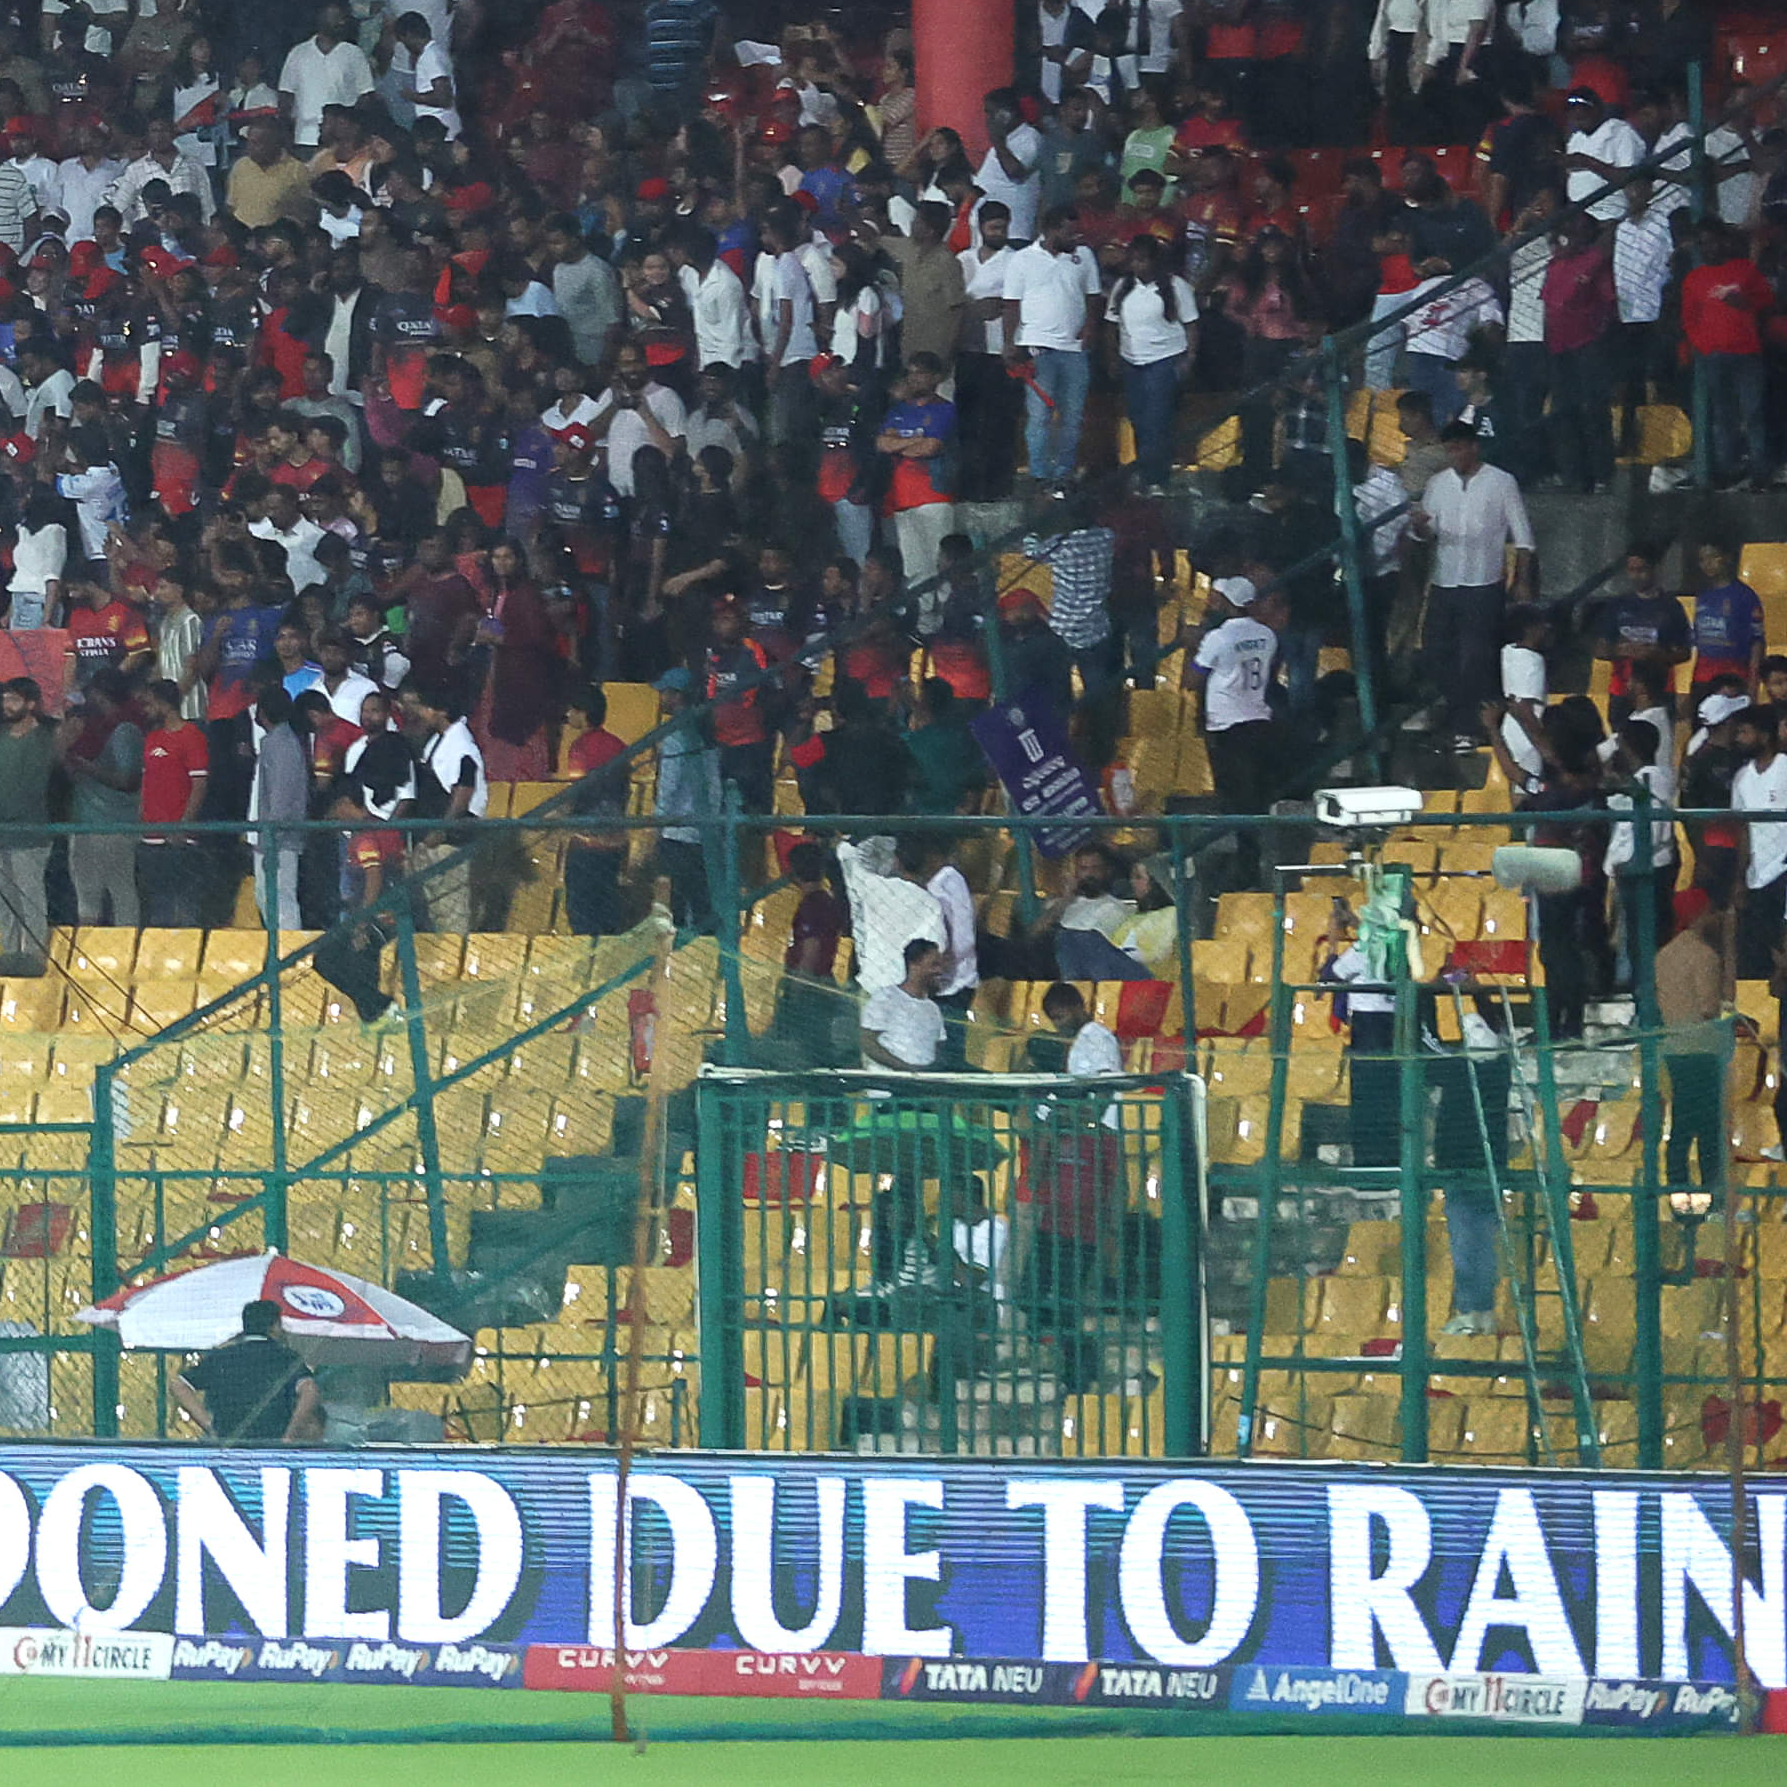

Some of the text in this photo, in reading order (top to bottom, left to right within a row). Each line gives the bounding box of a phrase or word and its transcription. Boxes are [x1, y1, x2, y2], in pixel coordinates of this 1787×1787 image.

[588, 1473, 952, 1657] DUE
[1007, 1479, 1258, 1667] TO
[1327, 1484, 1787, 1689] RAIN
[174, 1642, 246, 1675] RuPay
[258, 1642, 329, 1677] RuPay
[346, 1643, 421, 1678] RuPay
[435, 1645, 512, 1681] RuPay
[736, 1656, 846, 1675] CURVV
[926, 1663, 1042, 1694] TATA NEU
[1100, 1669, 1217, 1699] TATA NEU
[1272, 1676, 1388, 1711] AngelOne
